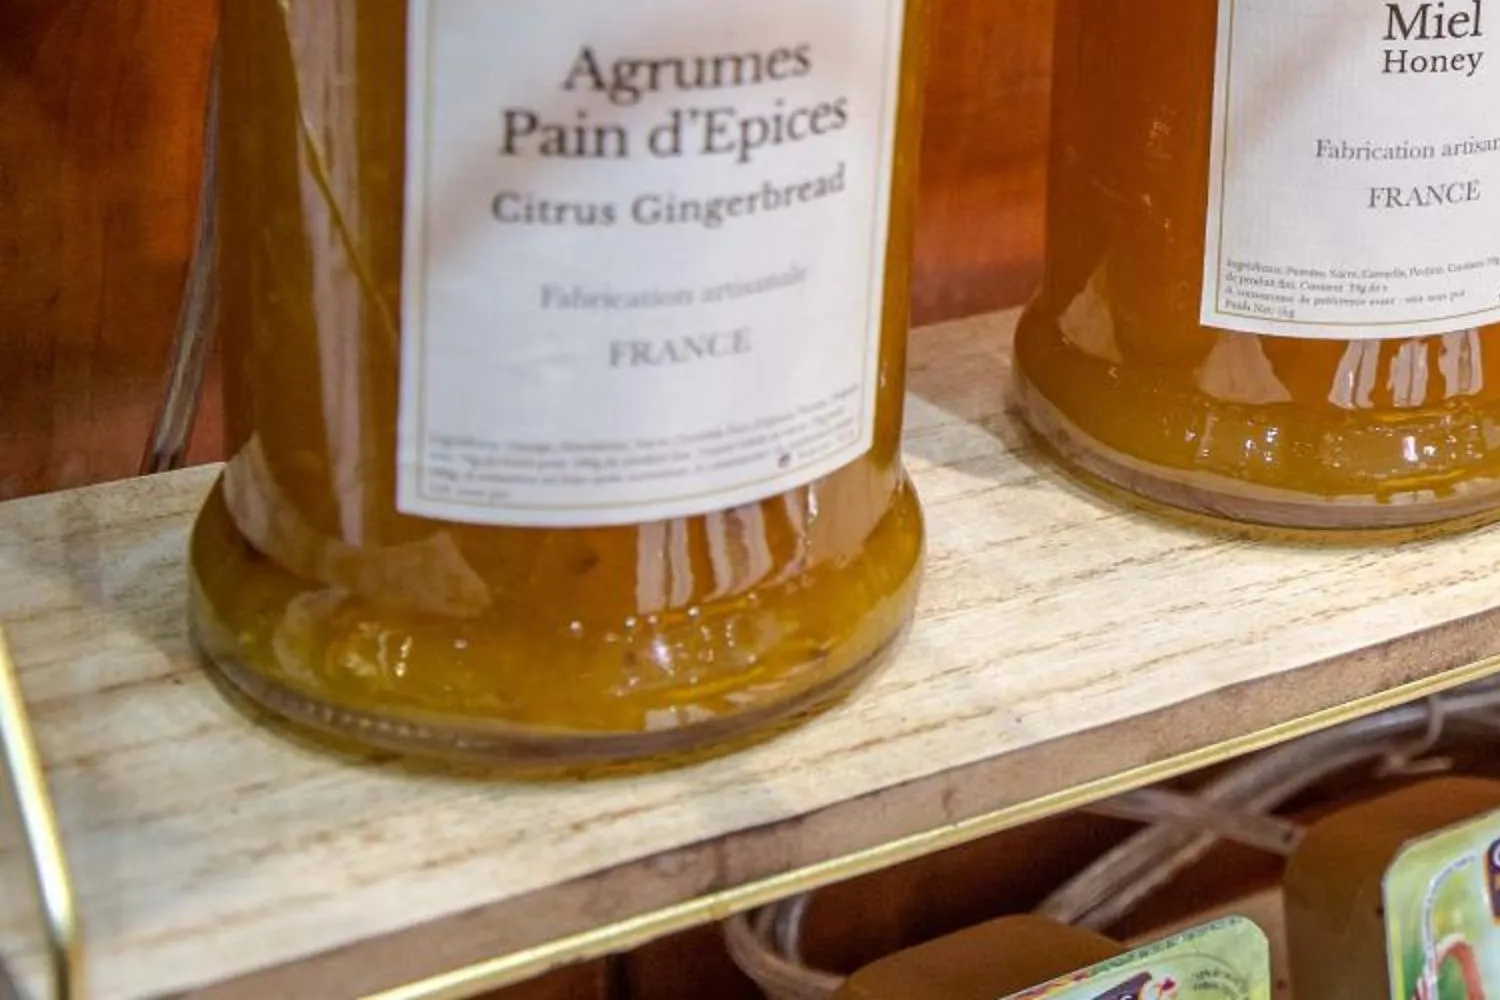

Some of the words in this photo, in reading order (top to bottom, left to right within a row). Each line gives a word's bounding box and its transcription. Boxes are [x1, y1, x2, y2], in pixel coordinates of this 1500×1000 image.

[560, 42, 812, 105] Agrumes
[1381, 49, 1484, 78] Honey
[498, 107, 630, 159] Pain
[647, 95, 849, 165] d'Epices
[1314, 137, 1436, 161] Fabrication
[491, 191, 617, 227] Citrus
[630, 162, 847, 228] Gingerbread
[1367, 179, 1482, 210] FRANCE
[539, 282, 694, 311] Fabrication
[607, 327, 753, 369] FRANCE
